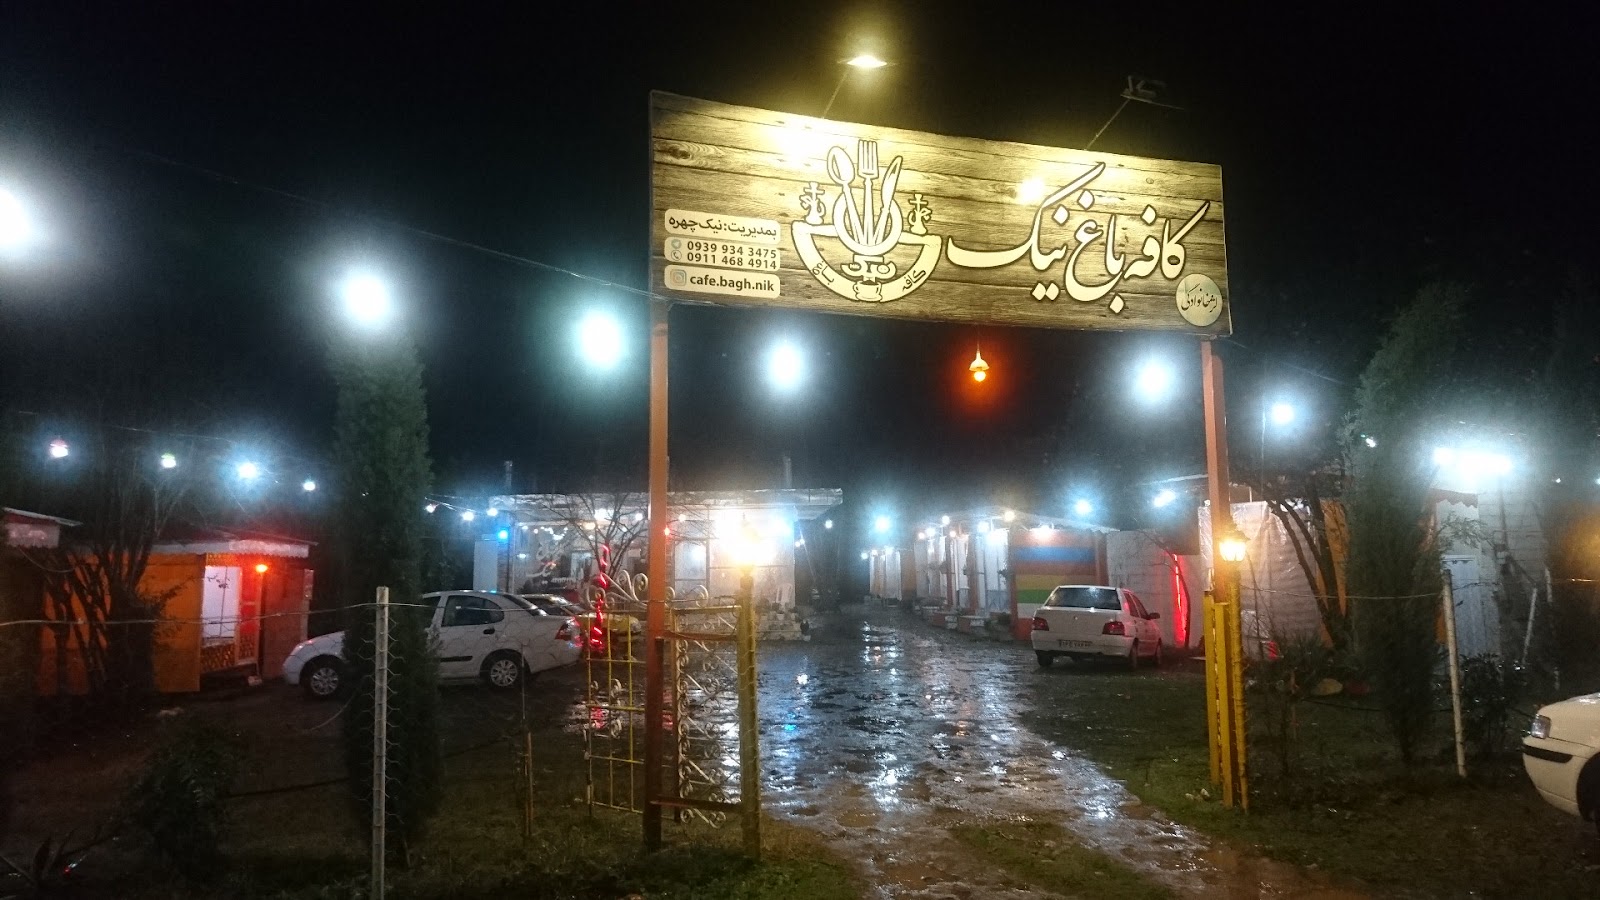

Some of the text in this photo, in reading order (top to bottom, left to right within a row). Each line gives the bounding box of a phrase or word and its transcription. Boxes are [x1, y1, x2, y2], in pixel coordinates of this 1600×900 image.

[946, 162, 1211, 314] کافه باغ نیک
[687, 241, 777, 259] 0939 934 3475
[687, 252, 777, 270] 0911 468 4914
[689, 274, 775, 292] cafe.bagh.nik
